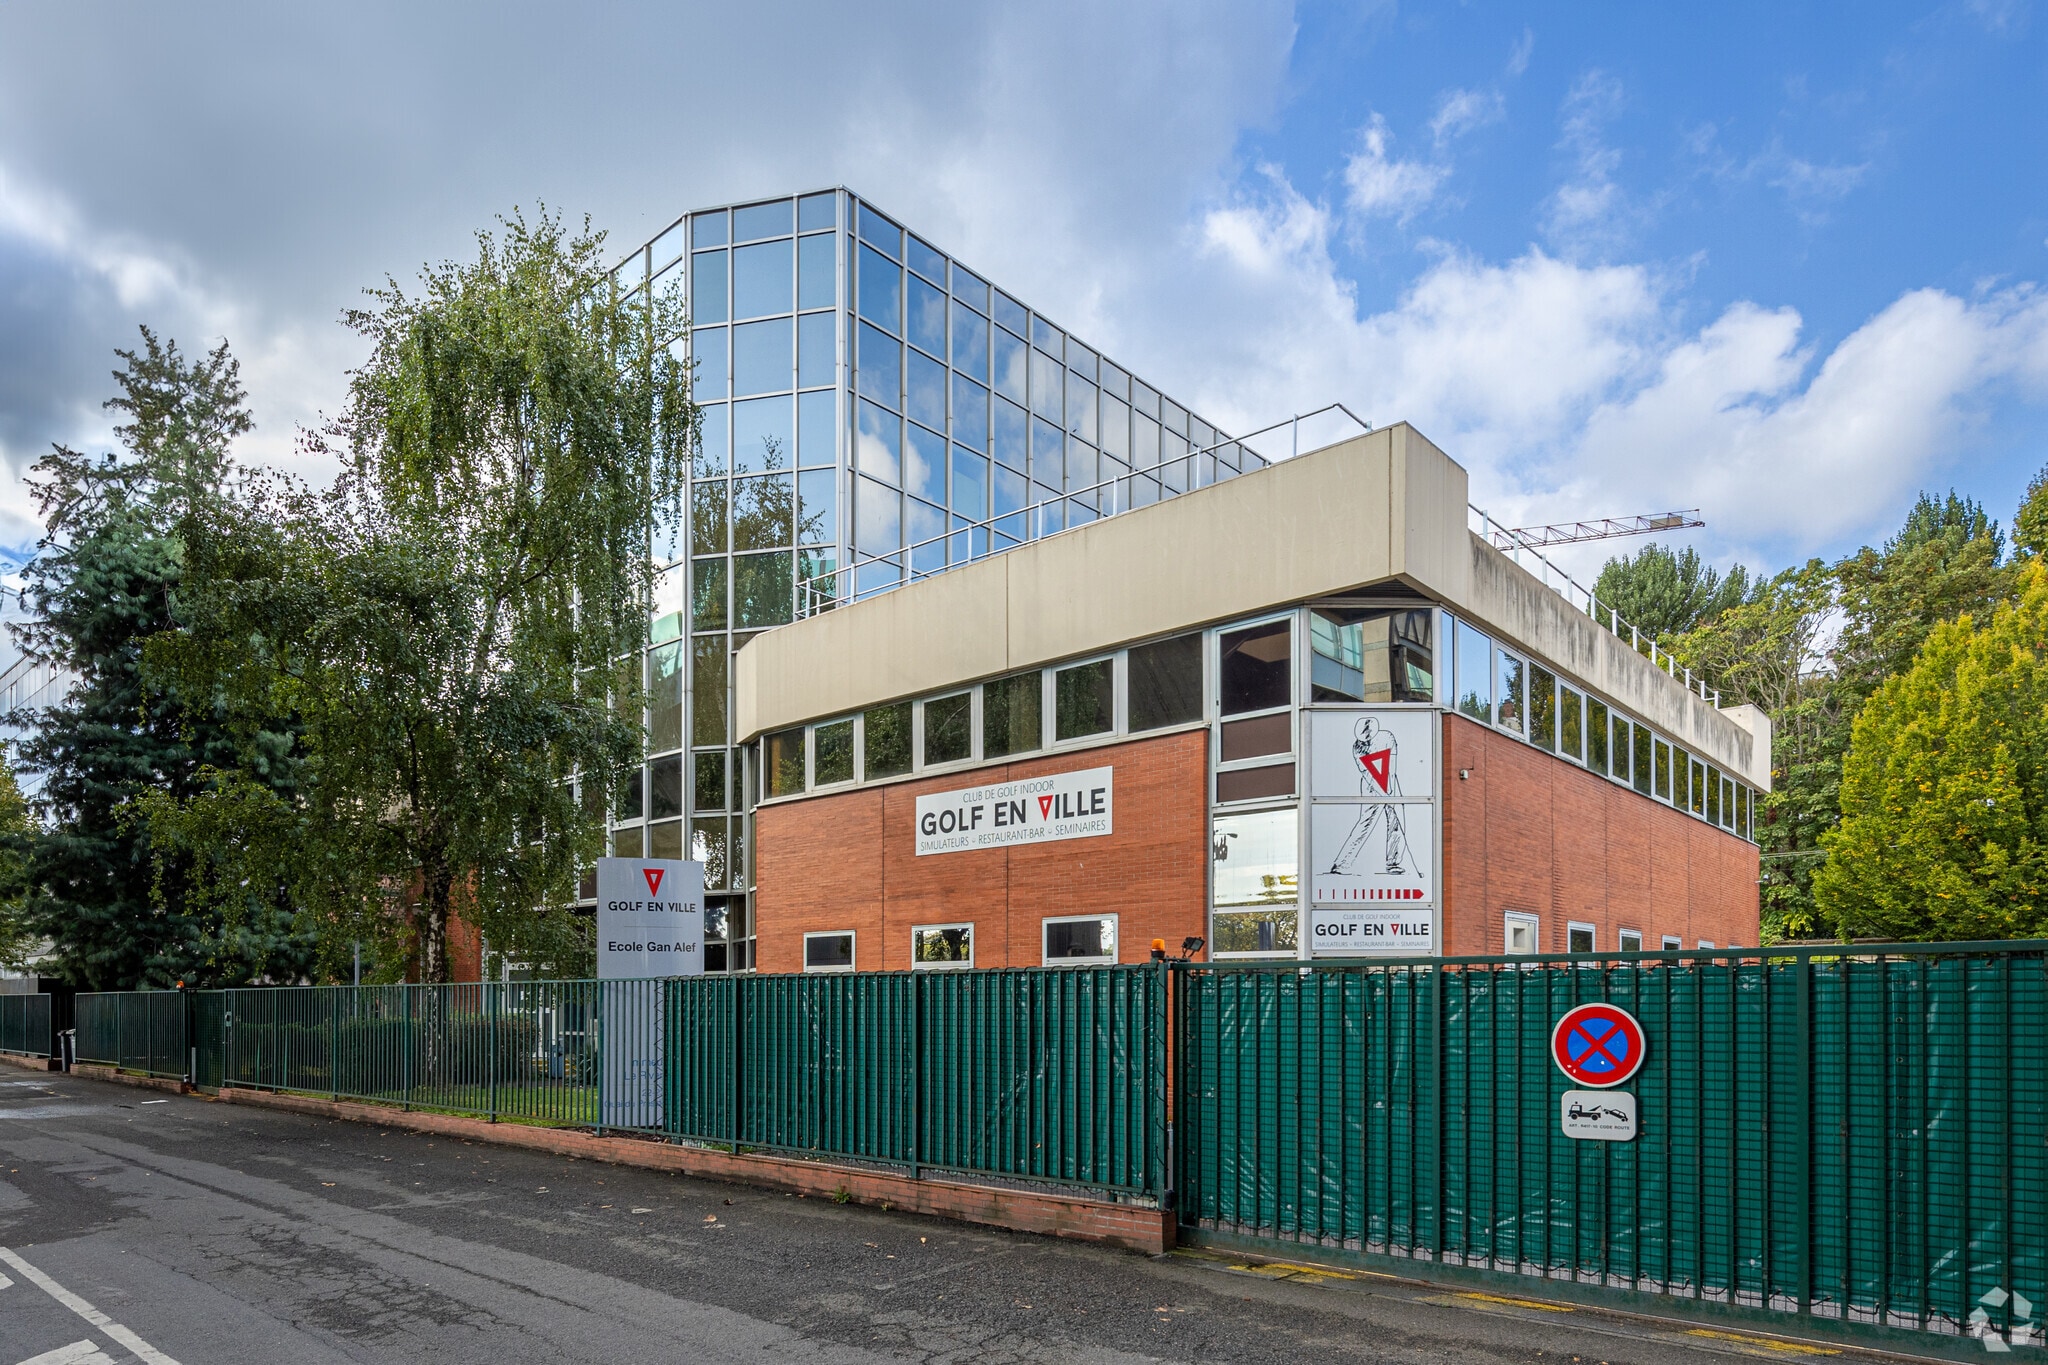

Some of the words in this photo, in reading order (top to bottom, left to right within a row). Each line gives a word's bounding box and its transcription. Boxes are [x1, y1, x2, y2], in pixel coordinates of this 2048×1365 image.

[962, 791, 983, 804] CLUB
[984, 789, 996, 800] DE
[996, 785, 1018, 798] GOLF
[1019, 779, 1055, 795] INDOOR
[920, 805, 984, 836] GOLF
[994, 799, 1026, 827] EN
[1037, 787, 1106, 822] VILLE
[920, 836, 969, 852] SIMULATEURS
[978, 826, 1045, 845] RESTAURANT-BAR
[1055, 819, 1106, 836] SEMINAIRES
[608, 901, 643, 912] GOLF
[647, 901, 664, 912] EN
[668, 902, 696, 913] VILLE
[1315, 923, 1358, 936] GOLF
[1364, 923, 1384, 936] EN
[1390, 923, 1430, 936] VILLE
[608, 941, 643, 952] Ecole
[647, 941, 671, 952] Gan
[673, 942, 697, 953] Alef
